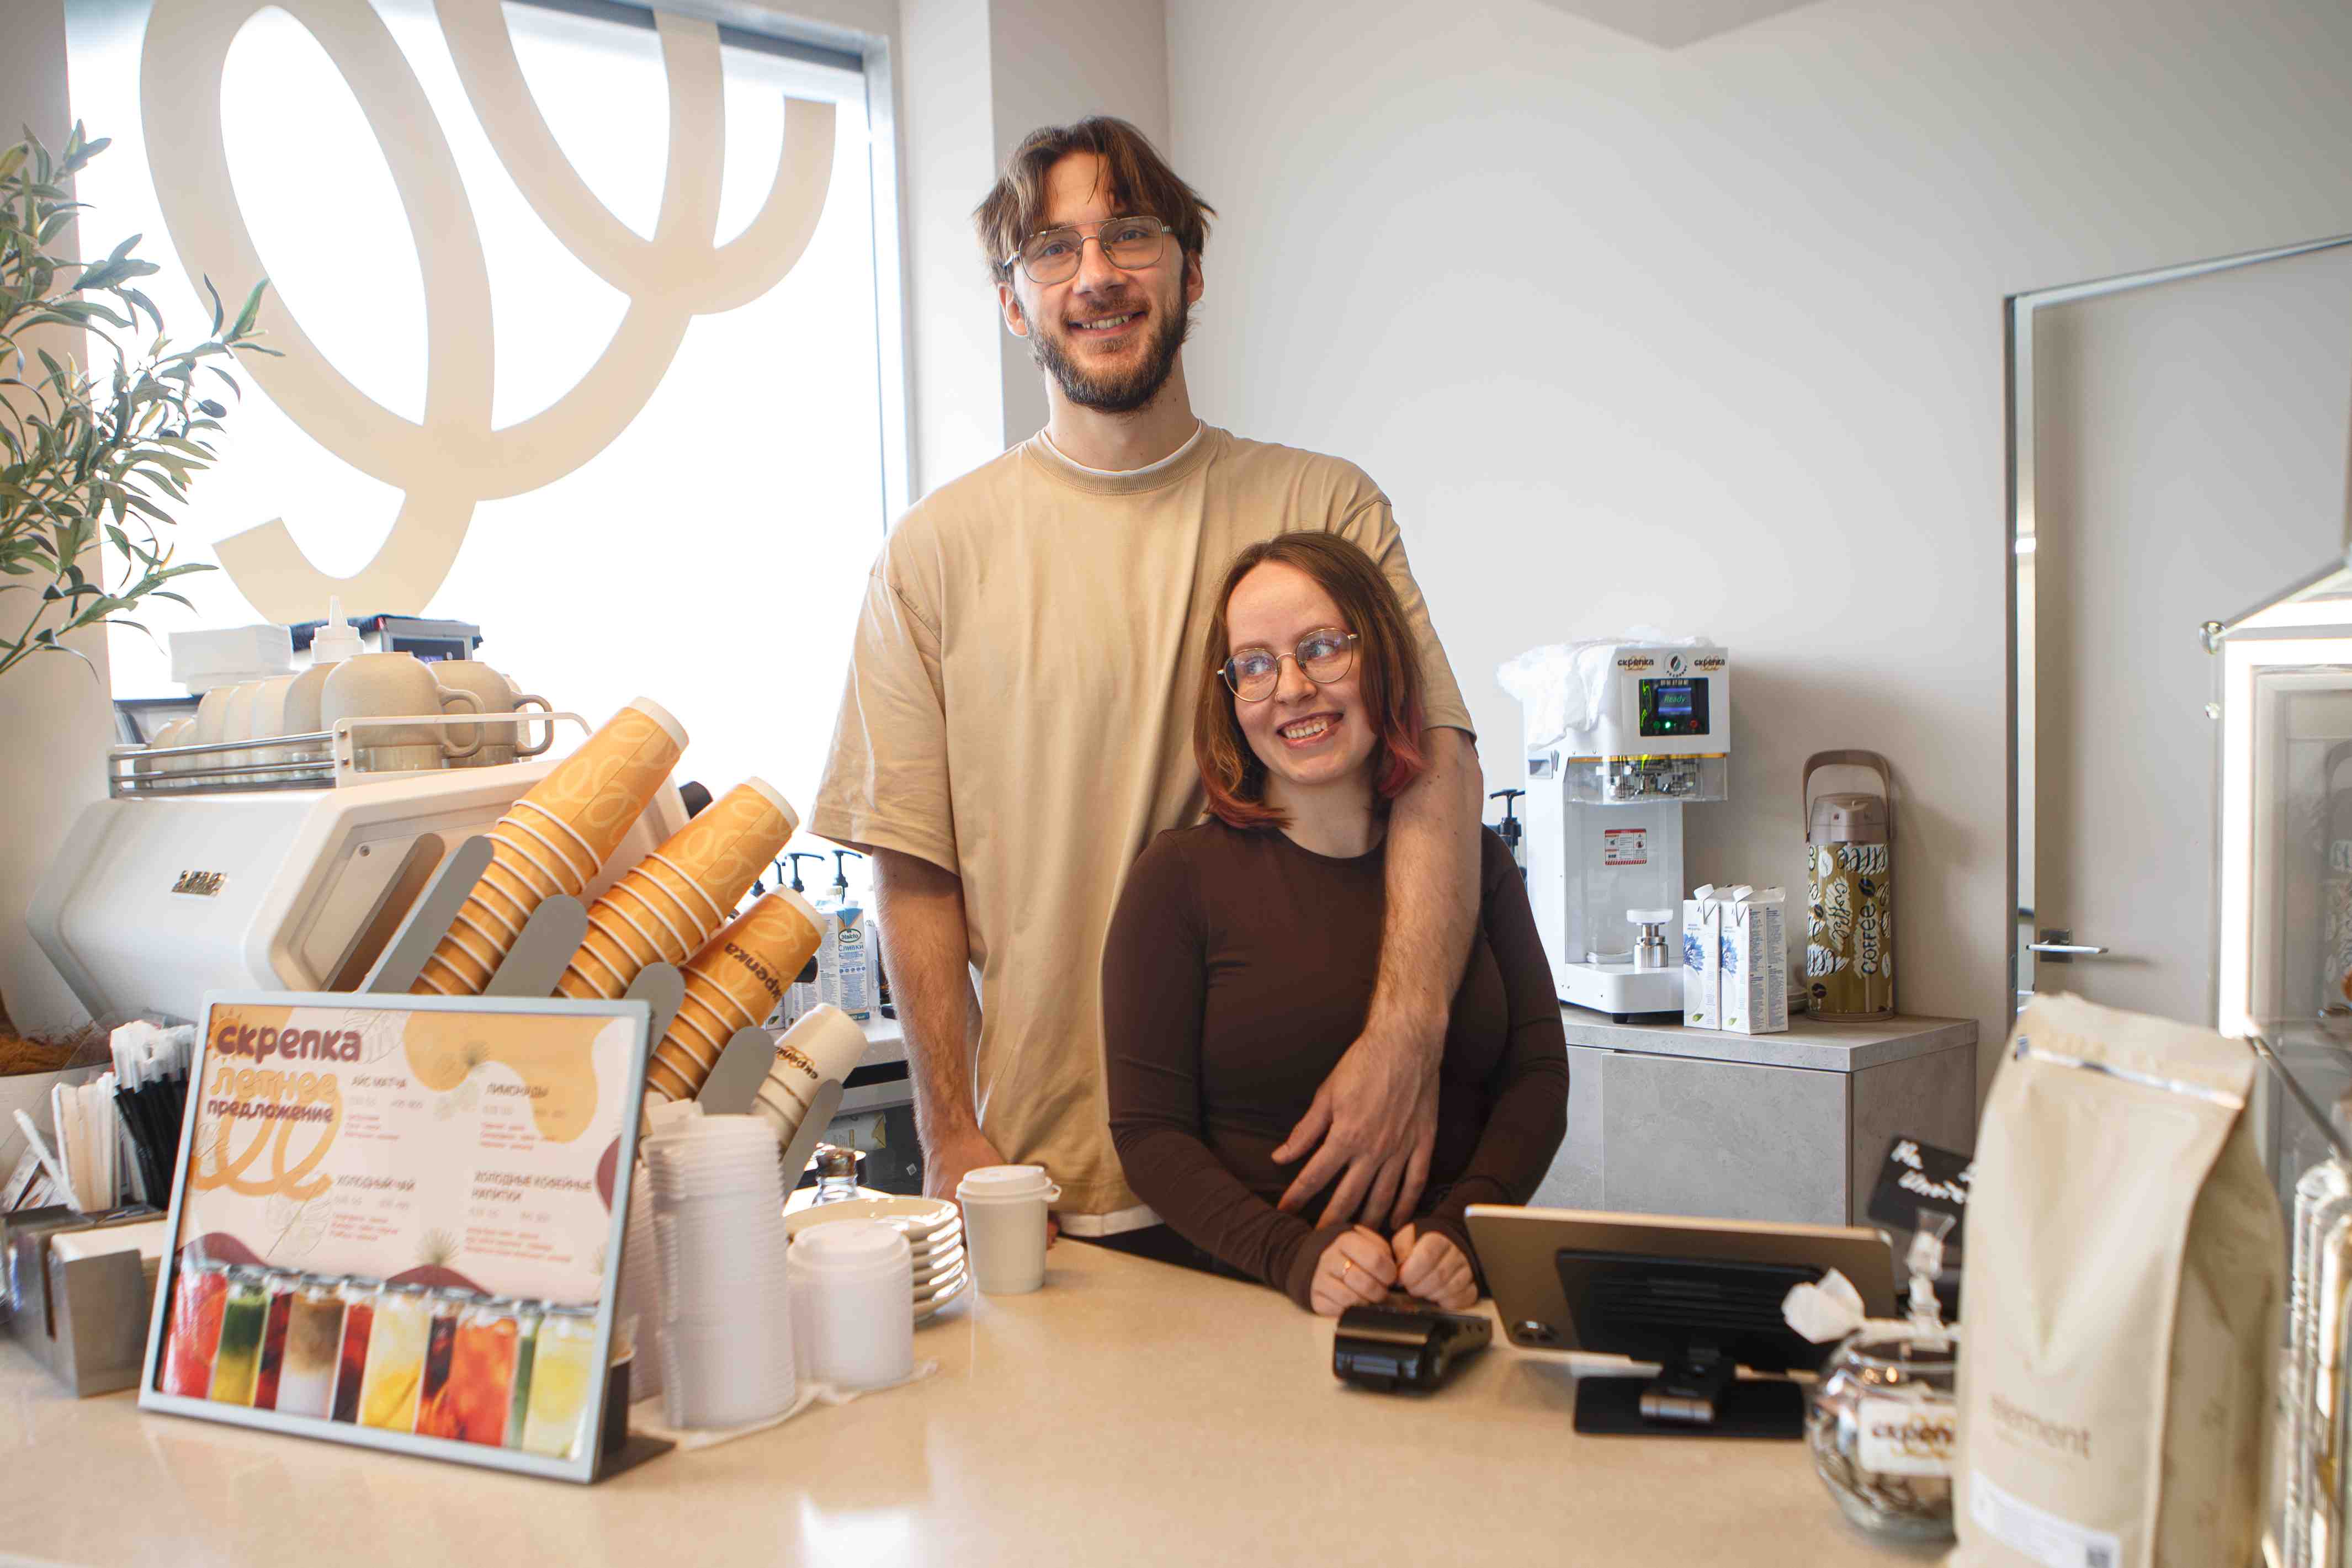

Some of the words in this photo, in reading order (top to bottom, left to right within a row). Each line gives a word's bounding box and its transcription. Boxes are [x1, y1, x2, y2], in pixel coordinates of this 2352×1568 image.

[1617, 657, 1654, 668] скрепка
[1694, 657, 1725, 668] скрепка
[1664, 693, 1686, 704] Ready
[217, 1024, 362, 1064] скрепка
[210, 1066, 337, 1103] летнее
[206, 1099, 334, 1123] предложение
